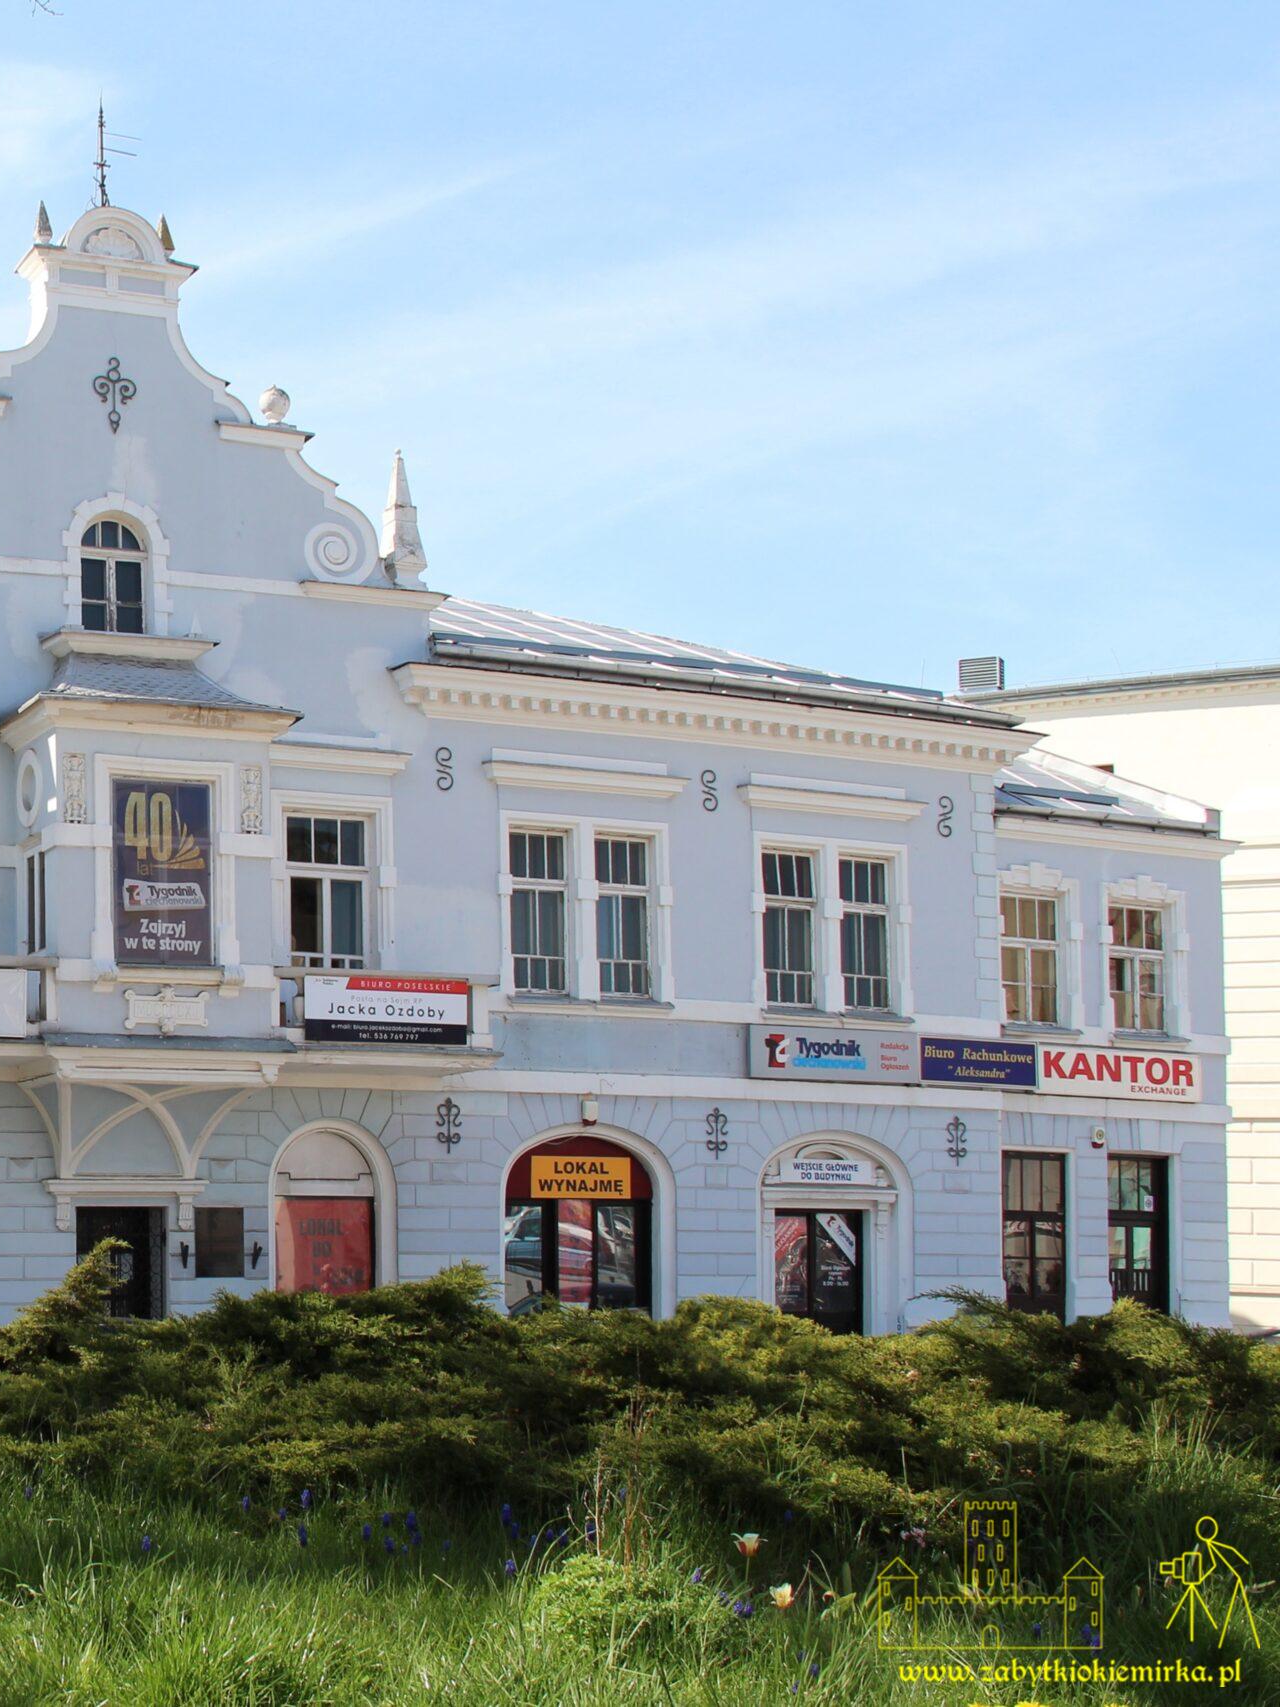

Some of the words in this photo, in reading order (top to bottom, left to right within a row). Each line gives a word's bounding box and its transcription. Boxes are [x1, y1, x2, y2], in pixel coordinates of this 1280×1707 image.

[124, 791, 172, 862] 40
[147, 885, 197, 899] Tygodnik
[140, 918, 186, 938] Zajrzyj
[124, 937, 139, 950] w
[159, 937, 202, 955] strony
[360, 981, 392, 989] BIURO
[397, 982, 451, 992] POSELSKIE
[328, 1003, 377, 1016] Jacka
[385, 1004, 445, 1021] Ozdoby
[373, 1032, 388, 1040] 536
[405, 1033, 419, 1041] 797
[796, 1037, 861, 1059] Tygodnik
[924, 1045, 955, 1059] Biuro
[962, 1047, 1033, 1064] Rachunkowe
[1043, 1050, 1194, 1087] KANTOR
[1130, 1085, 1187, 1096] EXCHANGE
[554, 1161, 609, 1175] LOKAL
[793, 1163, 823, 1172] WEJŚCIE
[825, 1162, 859, 1172] GŁÓWNE
[801, 1172, 812, 1180] DO
[814, 1172, 851, 1181] BUDYNKU
[538, 1179, 624, 1196] WYNAJMĘ
